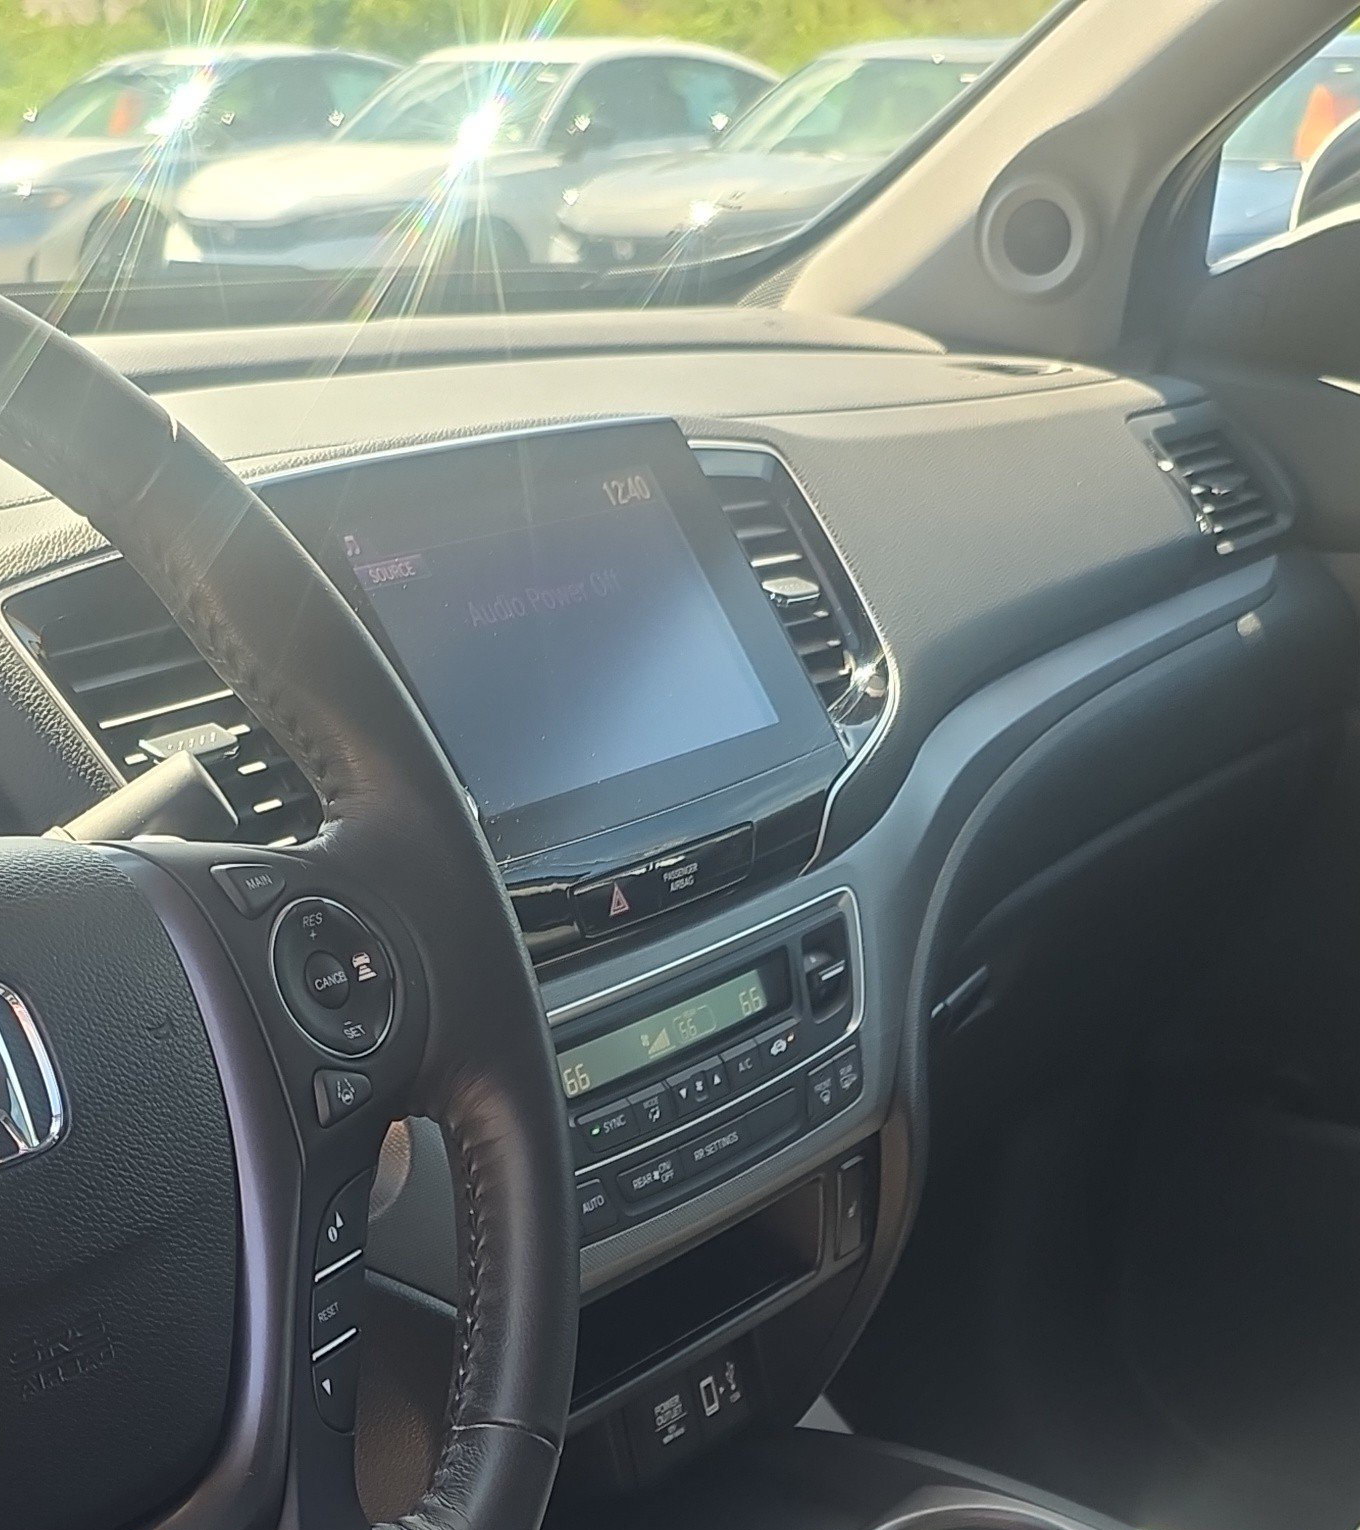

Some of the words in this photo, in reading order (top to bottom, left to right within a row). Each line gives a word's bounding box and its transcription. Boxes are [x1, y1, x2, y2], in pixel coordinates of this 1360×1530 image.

[368, 561, 416, 584] SOURCE
[468, 593, 525, 627] Audio
[526, 582, 586, 611] Power
[246, 874, 273, 891] MAIN
[303, 912, 323, 928] RES
[739, 986, 762, 1016] 66
[343, 1023, 367, 1040] SET
[562, 1063, 591, 1096] 66
[603, 1114, 627, 1133] SYNC
[704, 1131, 739, 1158] SETTINGS
[632, 1171, 653, 1191] REAR
[582, 1194, 605, 1215] AUTO
[317, 1301, 341, 1323] RESET
